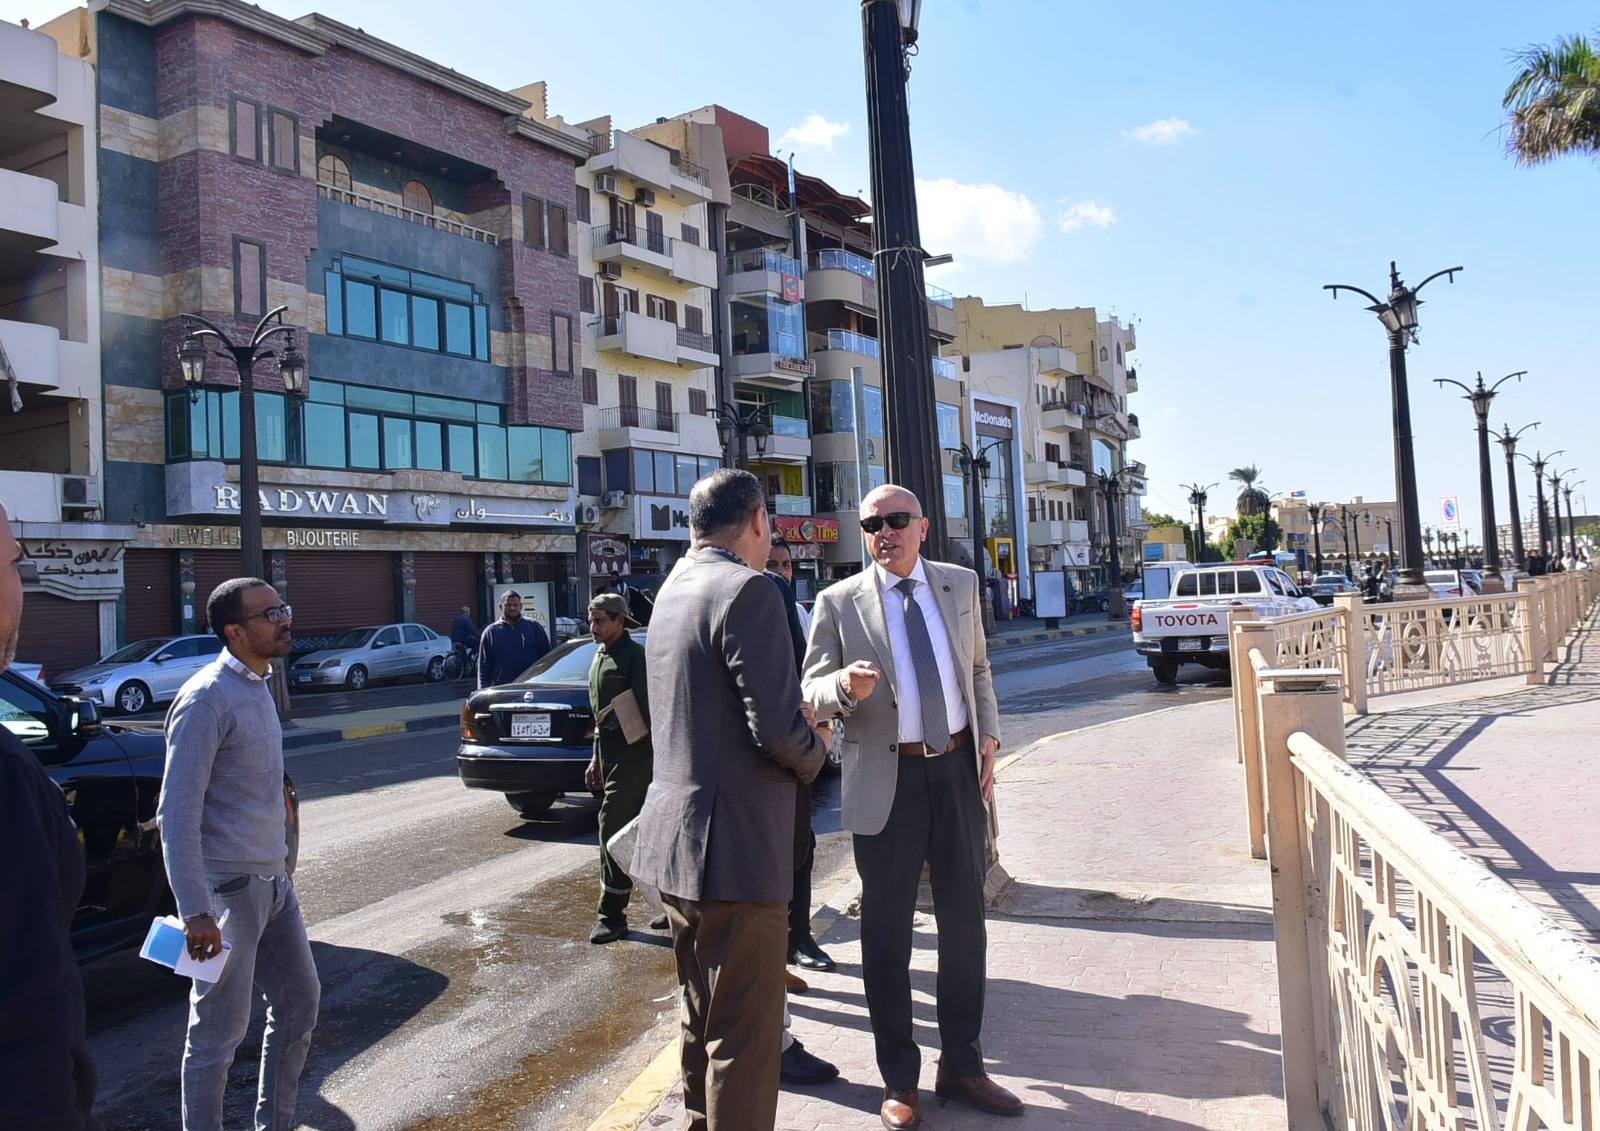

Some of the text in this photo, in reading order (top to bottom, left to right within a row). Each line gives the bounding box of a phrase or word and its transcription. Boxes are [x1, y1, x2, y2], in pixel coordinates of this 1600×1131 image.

[975, 410, 1012, 429] McDonald's
[214, 486, 389, 516] RADWAN
[457, 499, 573, 523] رضوان
[286, 530, 360, 547] BIJOUTERIE
[816, 525, 838, 540] Time
[1155, 614, 1218, 627] TOYOTA
